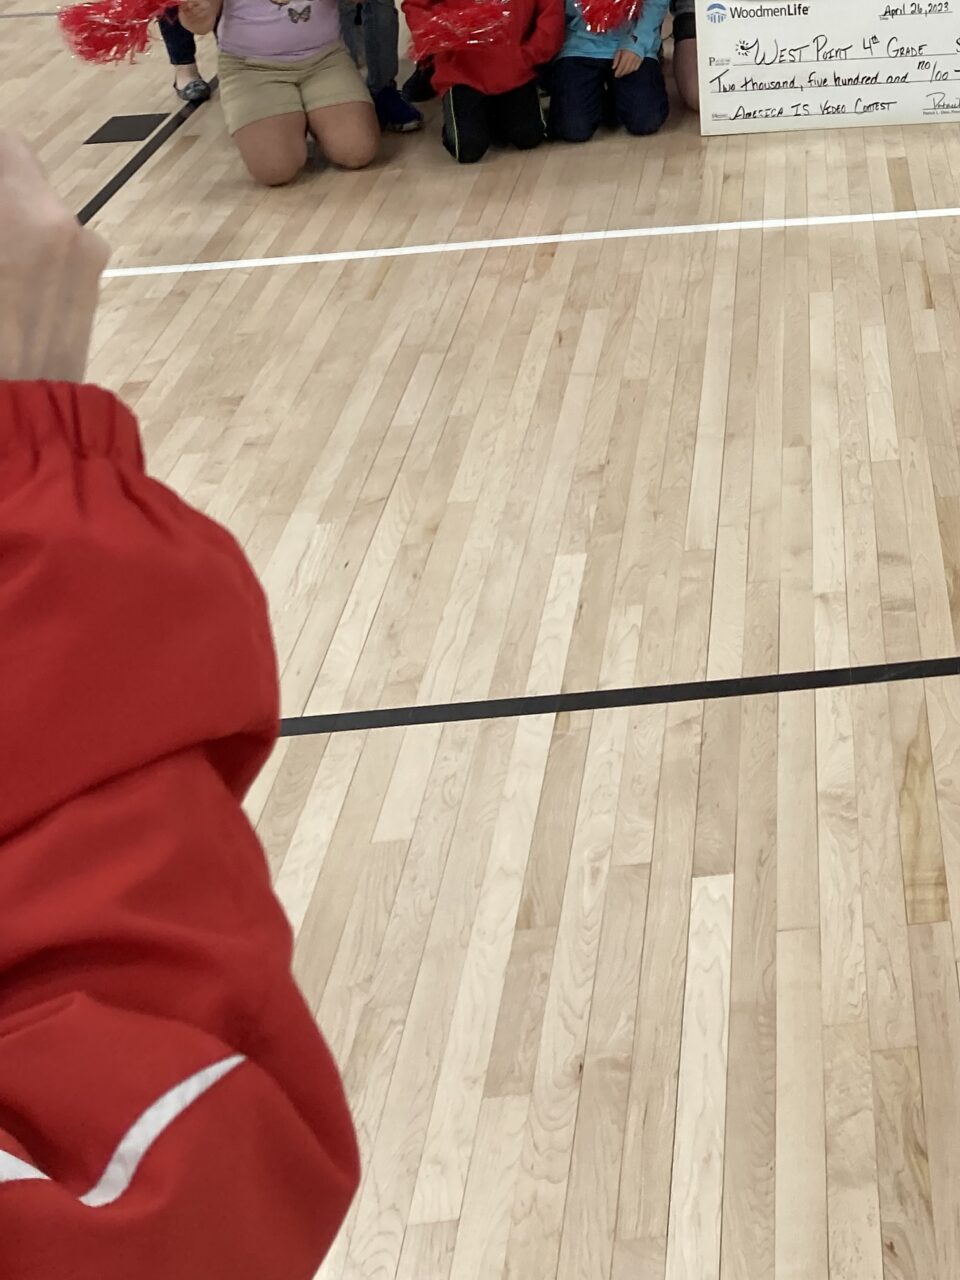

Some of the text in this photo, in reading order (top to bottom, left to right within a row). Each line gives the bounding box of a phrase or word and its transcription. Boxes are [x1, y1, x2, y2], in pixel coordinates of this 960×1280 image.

[730, 4, 810, 19] WoodmenLife
[883, 4, 906, 19] April
[742, 37, 810, 66] WEST
[886, 37, 928, 58] GRADE
[709, 69, 736, 93] Two
[807, 71, 828, 87] five
[833, 70, 881, 86] hundred
[886, 72, 909, 84] and
[791, 103, 810, 117] IS
[819, 99, 846, 115] VIDEO
